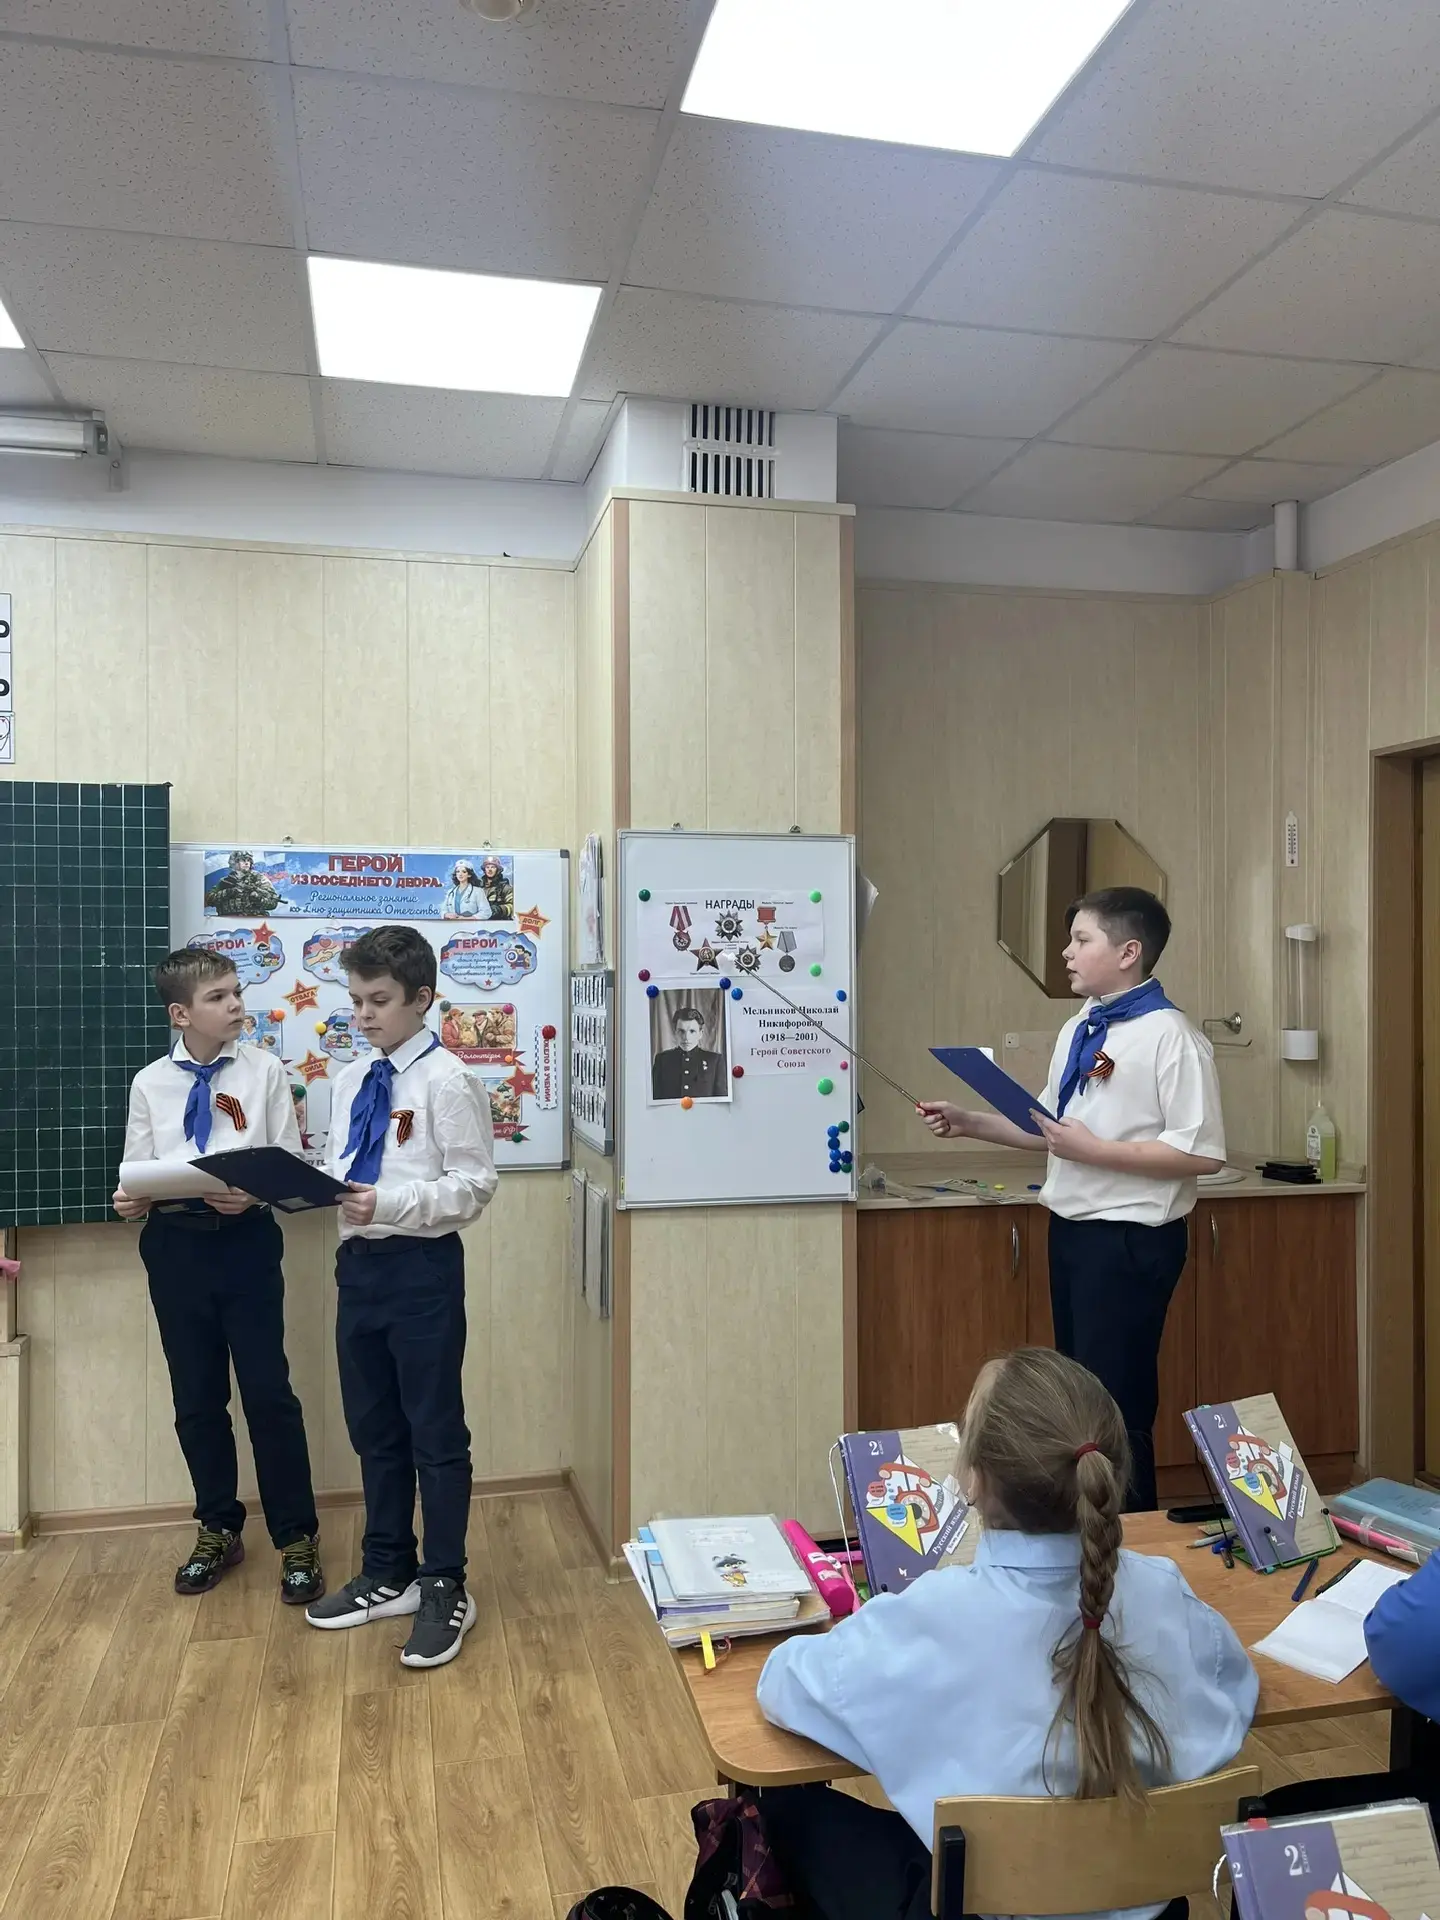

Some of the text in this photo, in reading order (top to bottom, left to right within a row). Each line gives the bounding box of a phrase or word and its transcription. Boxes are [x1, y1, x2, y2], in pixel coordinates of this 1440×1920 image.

[328, 853, 404, 873] ГЕРОЙ
[291, 874, 443, 889] ИЗ СОСЕДНЕГО ДВОРА.
[310, 890, 418, 906] Региональное занятие
[705, 899, 755, 911] НАГРАДЫ
[303, 902, 325, 914] Дню
[327, 905, 382, 918] защитника
[384, 904, 440, 915] Отечества
[455, 938, 498, 948] ГЕРОИ
[290, 990, 316, 1003] ОТВАГА
[743, 1007, 796, 1015] Мельников
[750, 1046, 832, 1057] Герой Советского
[776, 1060, 806, 1069] Союза
[1214, 1414, 1225, 1429] 2
[868, 1440, 879, 1456] 2
[1287, 1490, 1297, 1519] Русский
[931, 1524, 953, 1555] Русский
[949, 1507, 964, 1527] язык
[1284, 1844, 1303, 1876] 2
[1232, 1862, 1243, 1878] 2
